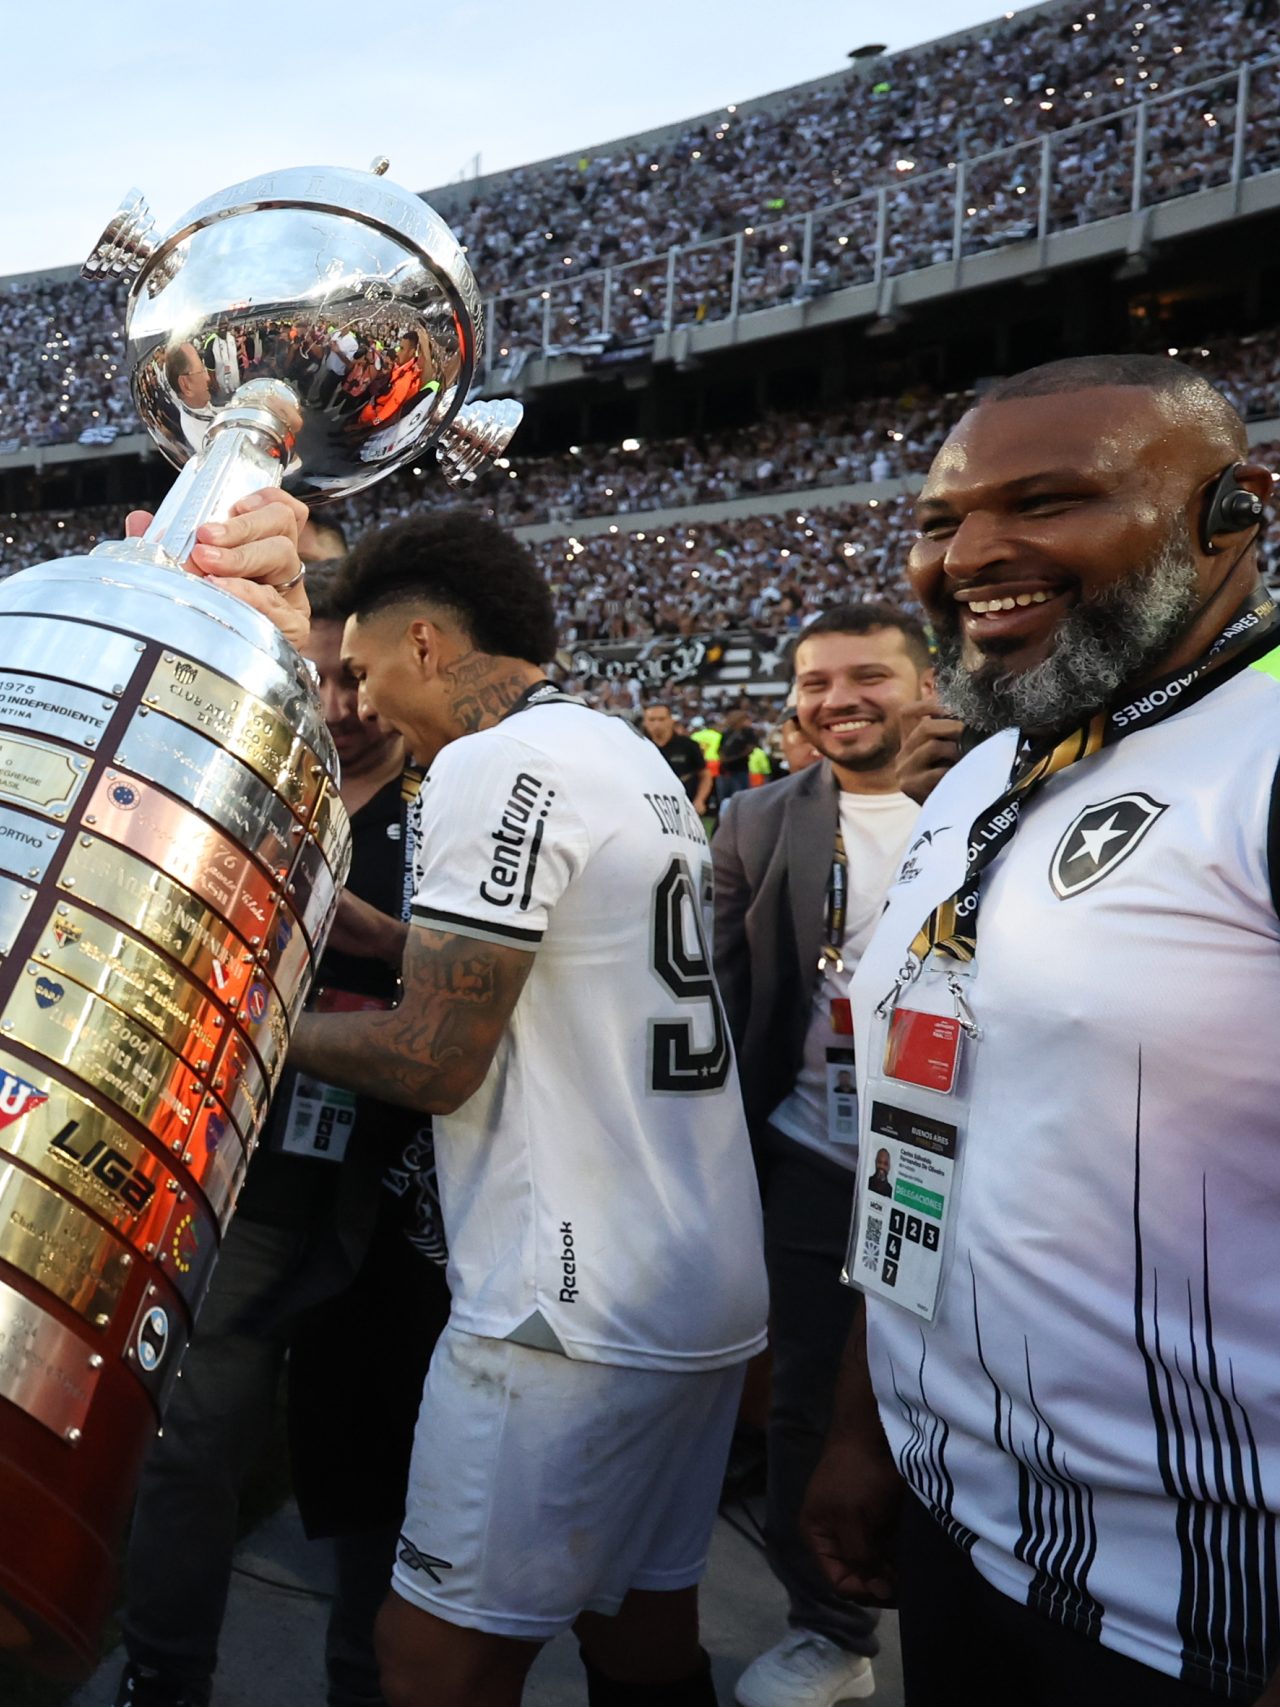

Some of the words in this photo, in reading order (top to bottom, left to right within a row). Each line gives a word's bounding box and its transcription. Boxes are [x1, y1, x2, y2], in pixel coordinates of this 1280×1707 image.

[7, 695, 105, 729] INDEPENDIENTE
[479, 772, 543, 907] Centrum
[894, 1215, 900, 1229] 1
[909, 1222, 917, 1237] 2
[926, 1229, 935, 1245] 3
[558, 1220, 577, 1304] Reebok
[888, 1239, 897, 1255] 4
[886, 1264, 894, 1279] 7
